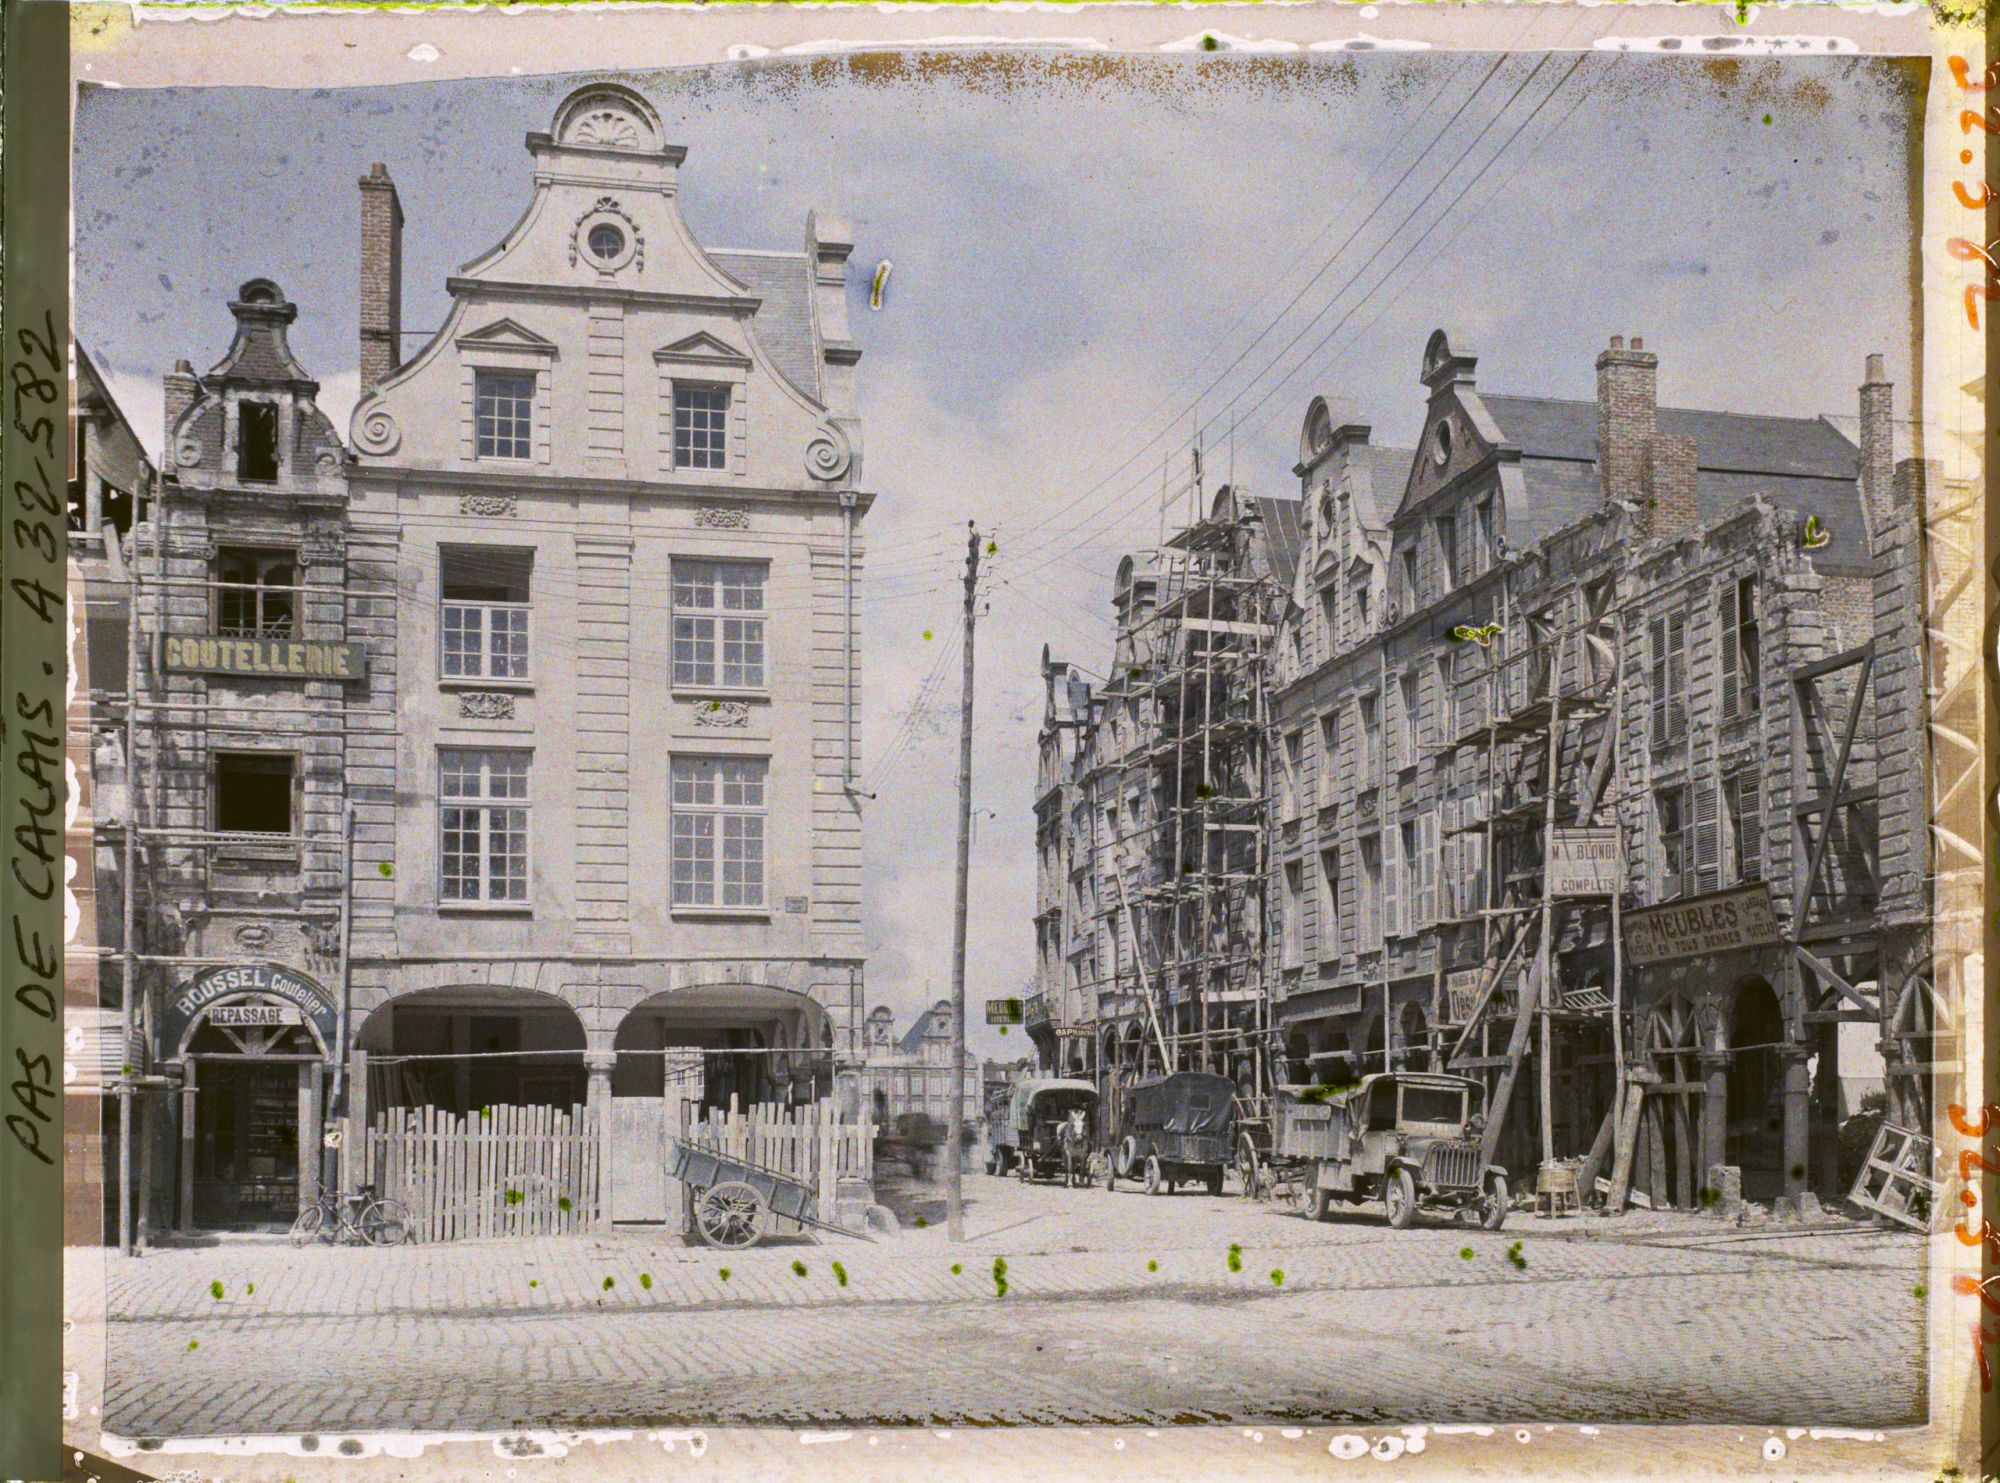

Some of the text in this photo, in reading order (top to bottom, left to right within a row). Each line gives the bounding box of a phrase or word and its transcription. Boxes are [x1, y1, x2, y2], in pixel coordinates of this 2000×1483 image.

[165, 636, 350, 677] COUTELLERIE
[1648, 900, 1738, 943] MEUBLES
[1674, 937, 1700, 952] TOUS
[1704, 929, 1742, 949] GENRES
[13, 914, 58, 1022] DE
[211, 1007, 284, 1025] REPASSAGE
[270, 972, 328, 1017] Coutelier
[6, 1047, 56, 1165] PAS
